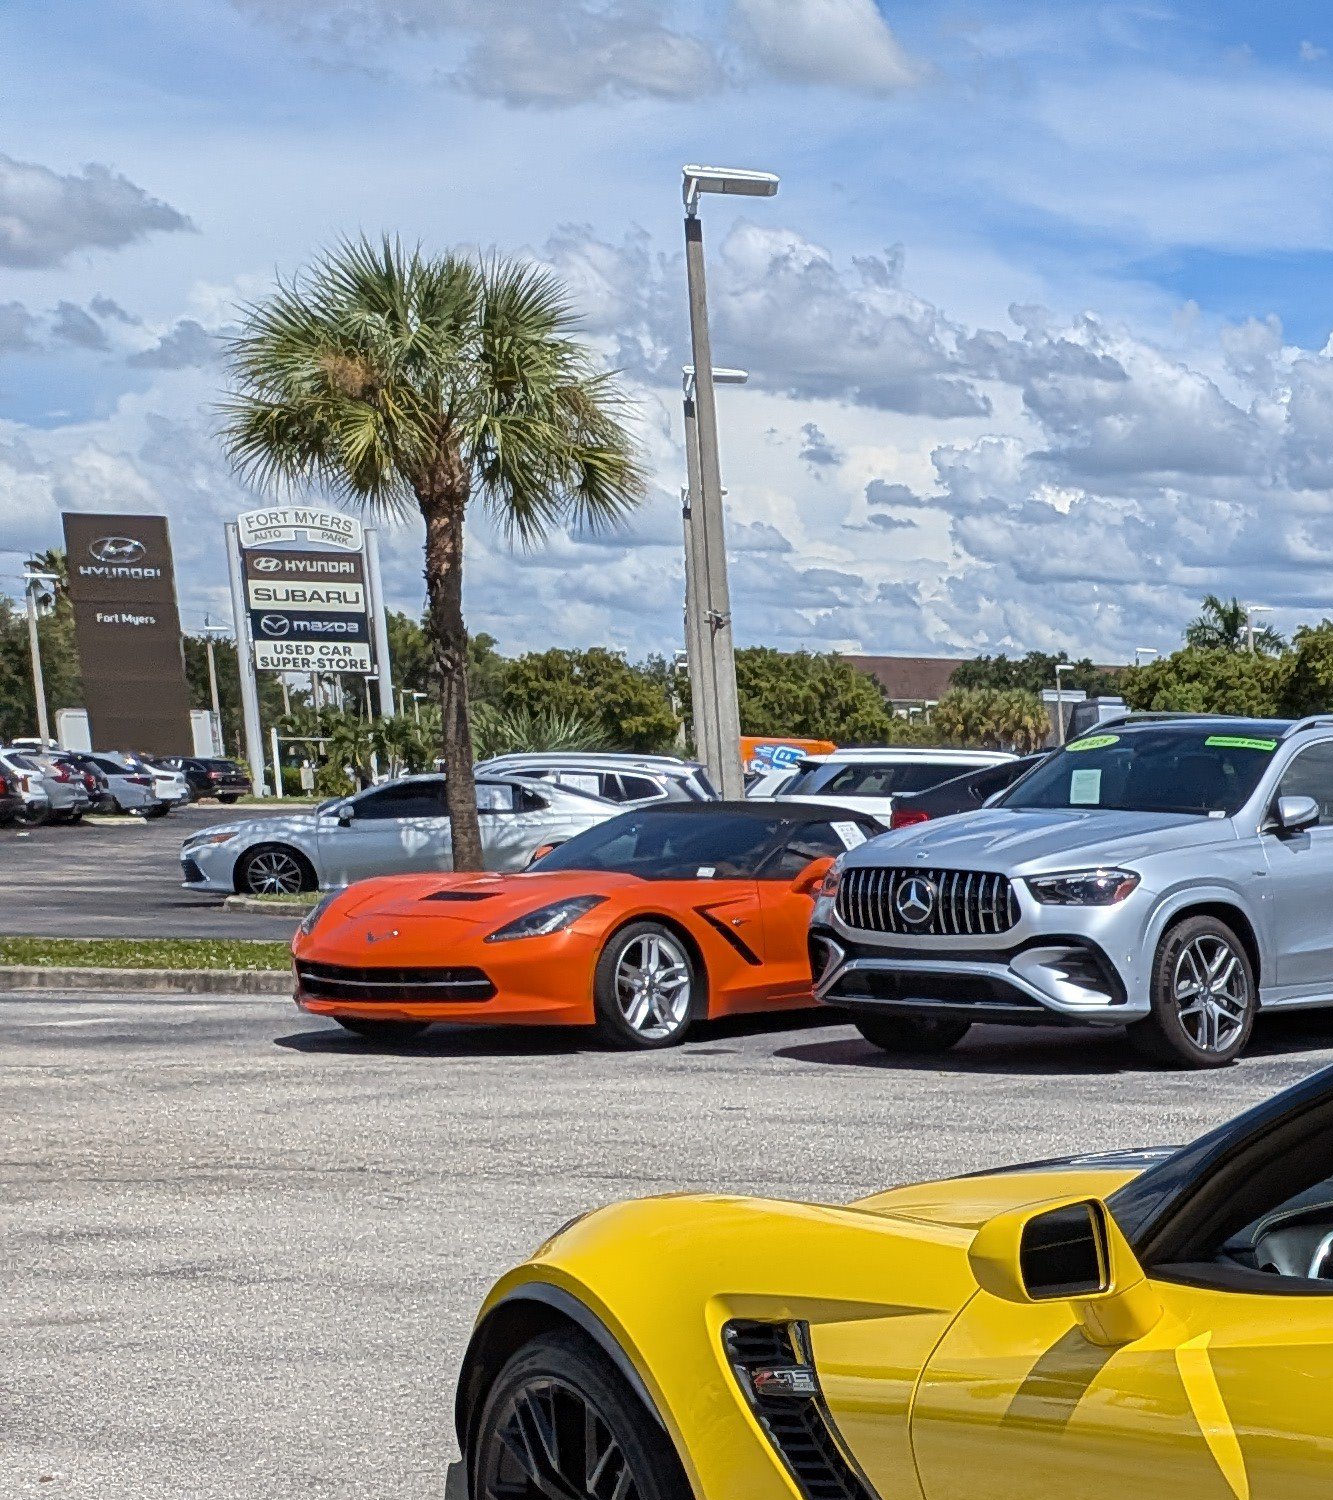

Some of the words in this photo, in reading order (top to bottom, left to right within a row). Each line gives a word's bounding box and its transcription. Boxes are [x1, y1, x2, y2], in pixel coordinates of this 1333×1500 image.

[245, 511, 289, 529] FORT
[294, 511, 353, 533] MYERS
[253, 529, 282, 541] AUTO
[321, 531, 348, 545] PARK
[79, 565, 161, 579] HYUNDAI
[284, 559, 355, 574] HYUNDAI
[253, 587, 360, 605] SUBARU
[96, 612, 119, 624] Fort
[121, 612, 156, 626] Myers
[273, 643, 315, 656] USED
[318, 645, 352, 657] CAR
[260, 656, 368, 670] SUPER-STORE
